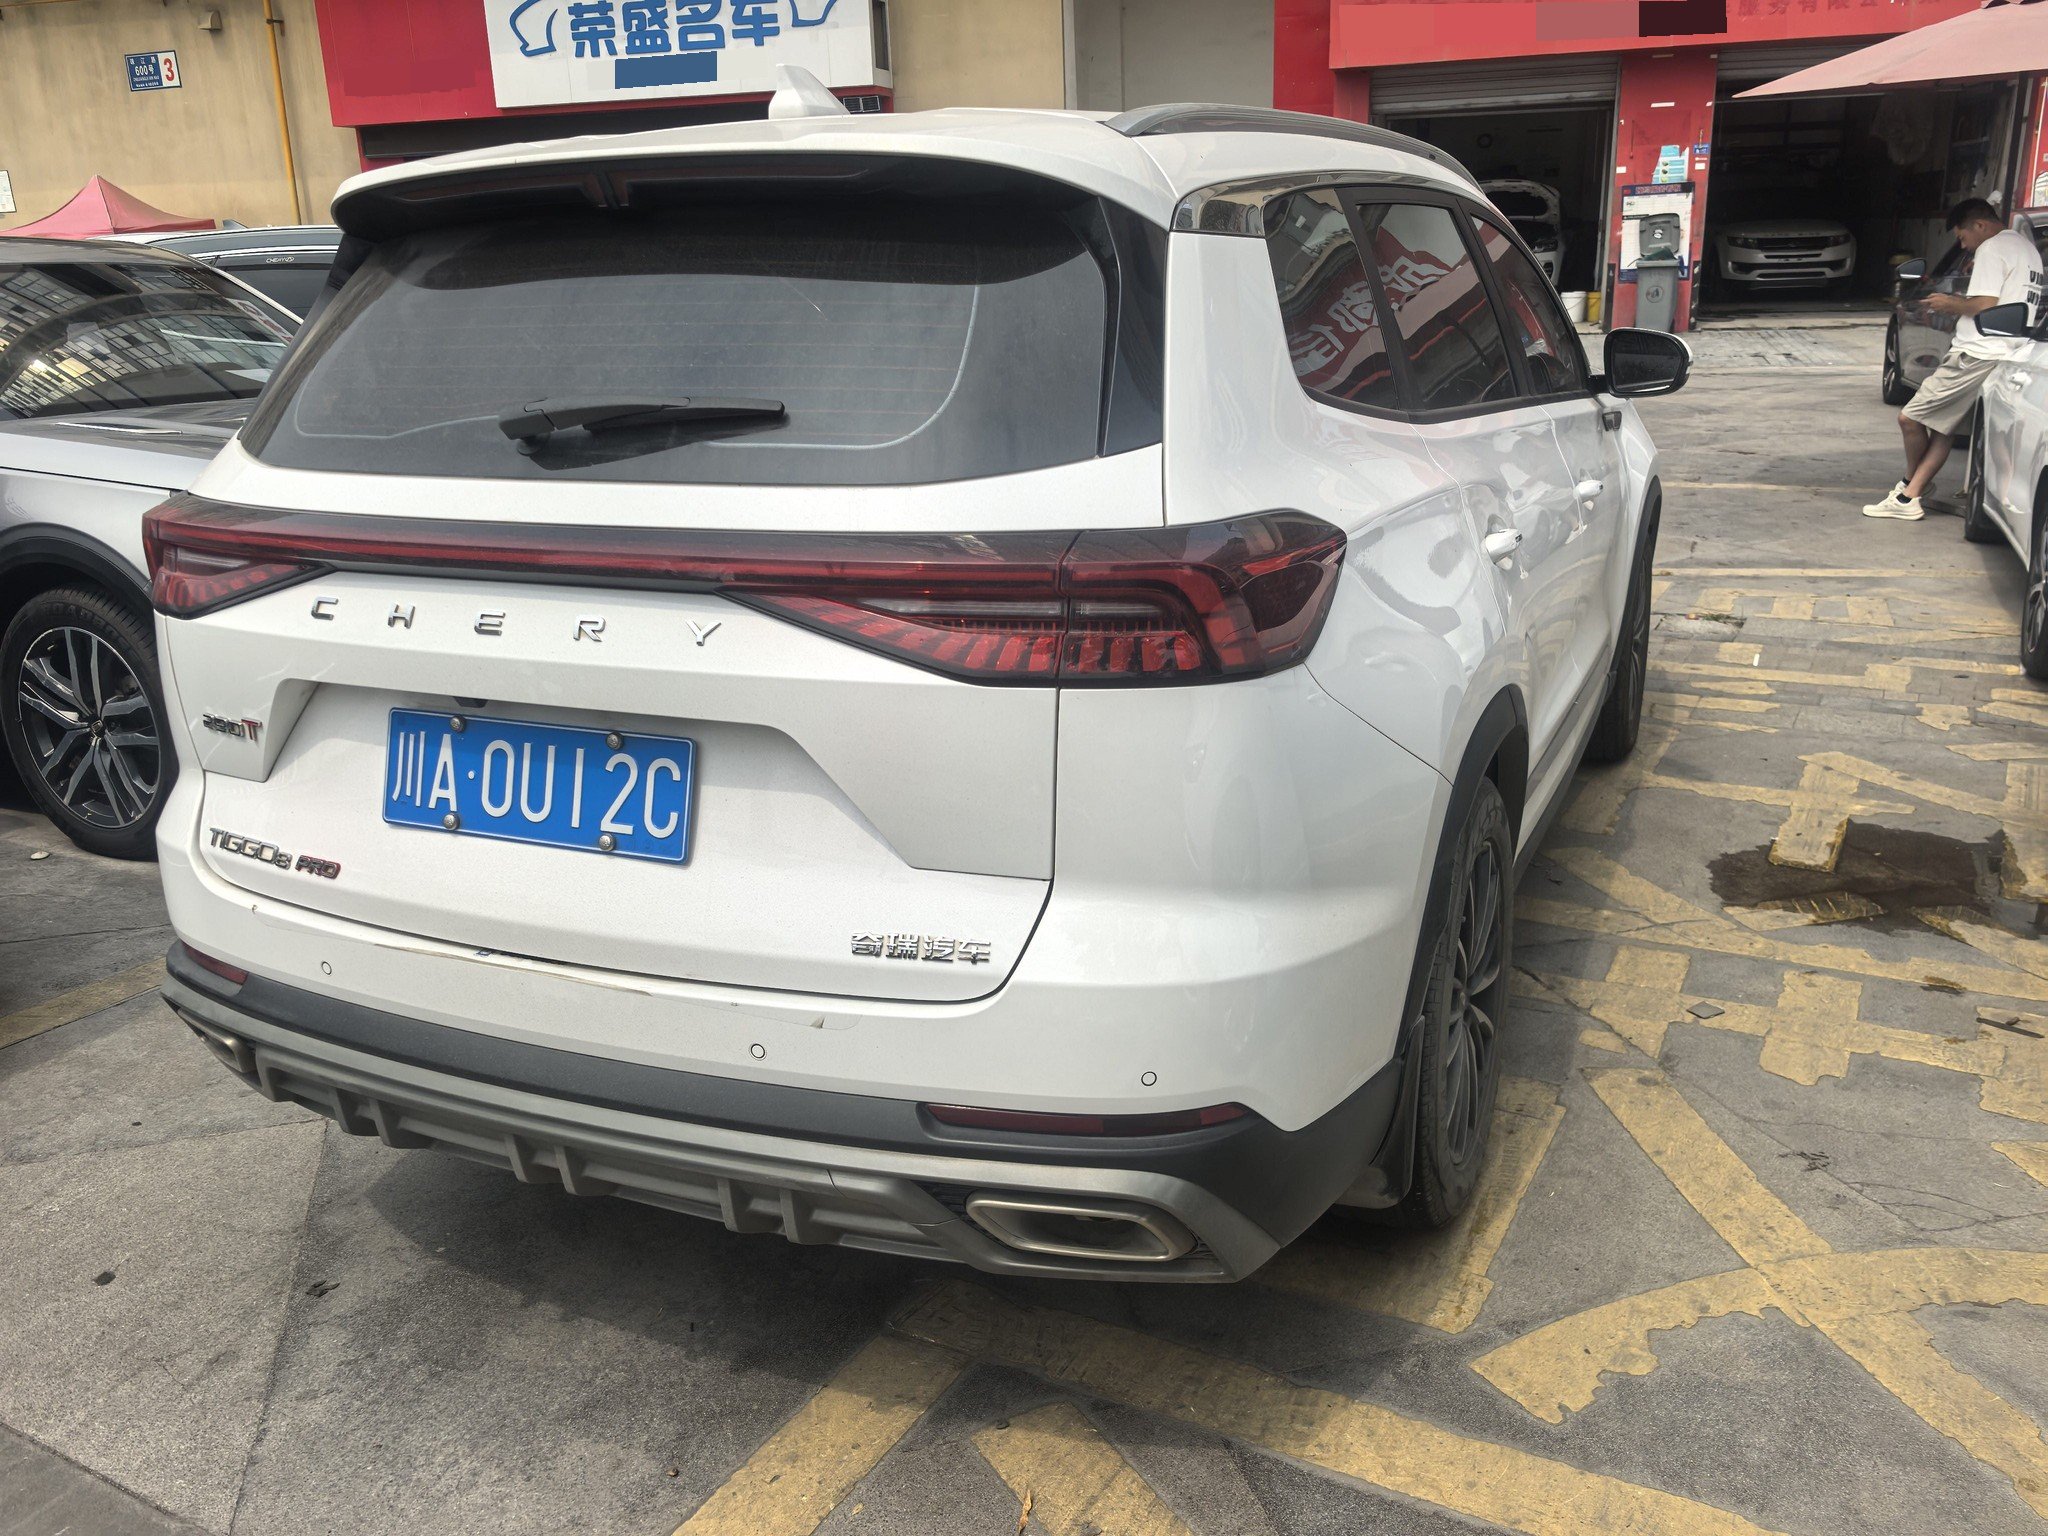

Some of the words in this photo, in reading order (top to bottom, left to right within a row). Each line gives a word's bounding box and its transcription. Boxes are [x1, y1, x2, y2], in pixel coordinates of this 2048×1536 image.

[567, 0, 780, 58] 荣盛名车
[134, 64, 154, 76] 600号
[163, 57, 175, 82] 3
[310, 595, 722, 647] CHERY
[294, 854, 342, 880] PRO
[851, 931, 992, 965] 奇瑞汽车
